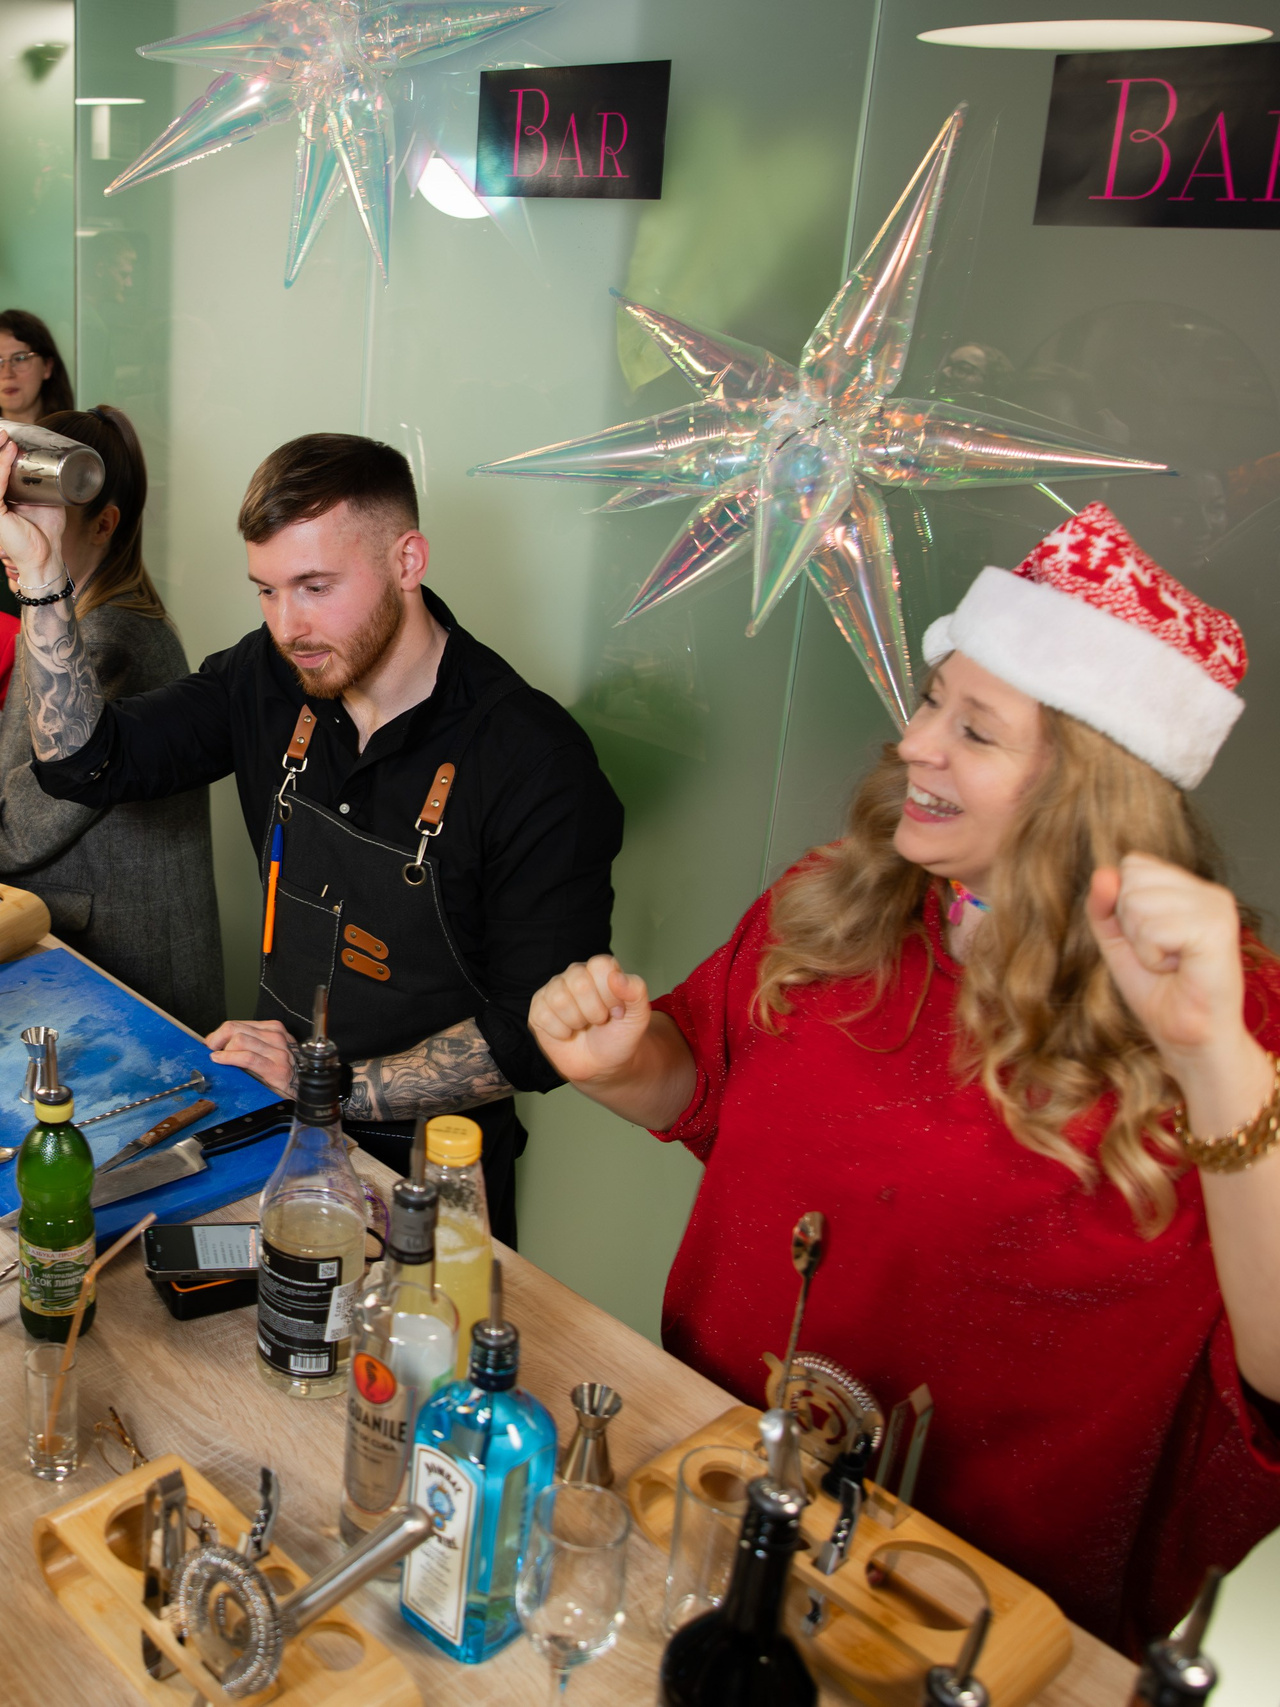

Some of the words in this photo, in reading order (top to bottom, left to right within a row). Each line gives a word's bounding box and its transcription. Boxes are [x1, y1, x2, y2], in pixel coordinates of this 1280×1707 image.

[505, 88, 630, 178] BAR
[1088, 77, 1280, 203] BA
[34, 1277, 52, 1287] СОК
[54, 1275, 85, 1288] ЛИМО
